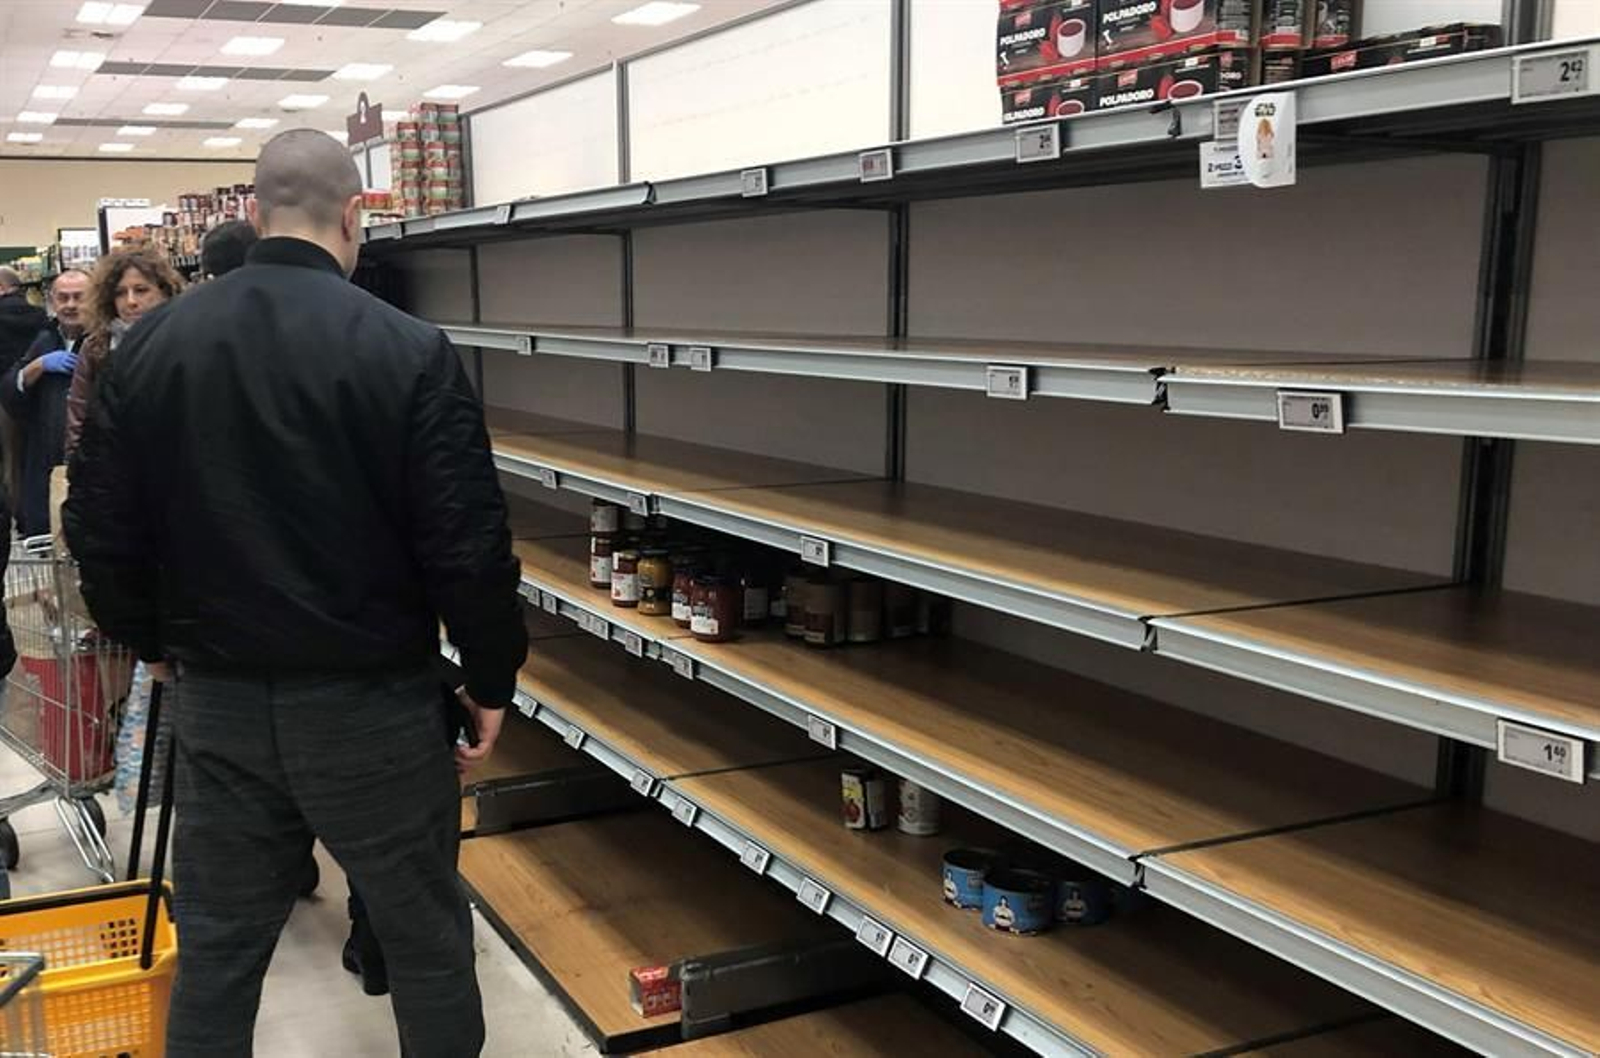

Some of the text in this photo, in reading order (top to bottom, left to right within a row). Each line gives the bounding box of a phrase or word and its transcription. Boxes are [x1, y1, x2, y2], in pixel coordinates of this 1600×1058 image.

[1102, 2, 1157, 24] POLPADORO
[1000, 28, 1046, 46] POLPADORO
[1099, 88, 1155, 108] POLPADORO
